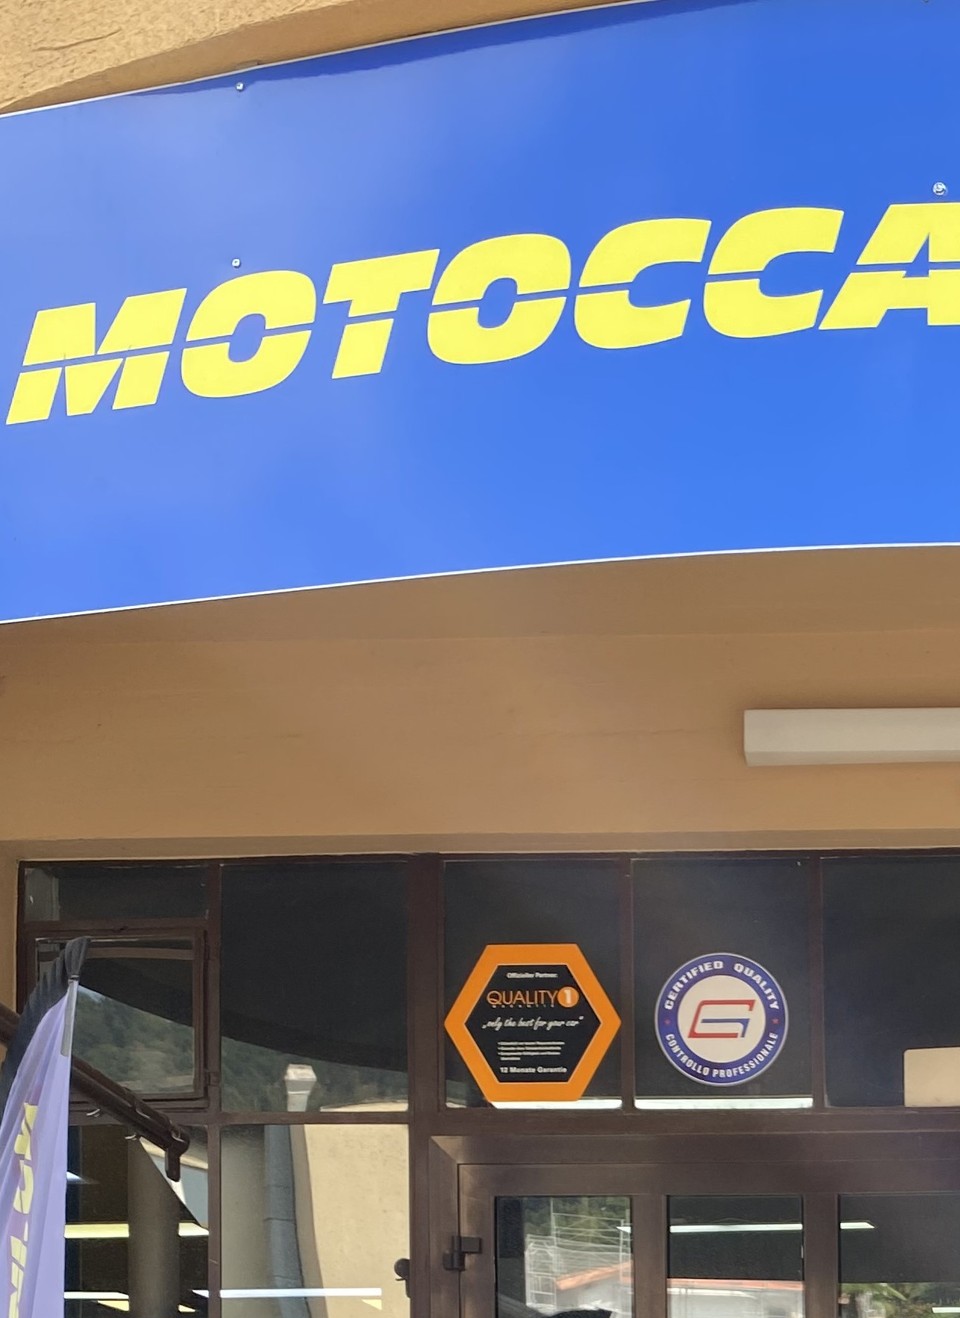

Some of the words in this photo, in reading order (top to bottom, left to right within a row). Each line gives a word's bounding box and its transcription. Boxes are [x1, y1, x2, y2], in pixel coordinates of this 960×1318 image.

[486, 990, 558, 1005] QUALITY
[664, 961, 723, 1010] CERTIFIED
[733, 963, 779, 1010] QUALITY
[665, 1033, 709, 1076] CONTROLLO
[712, 1032, 778, 1077] PROFESSIONALE
